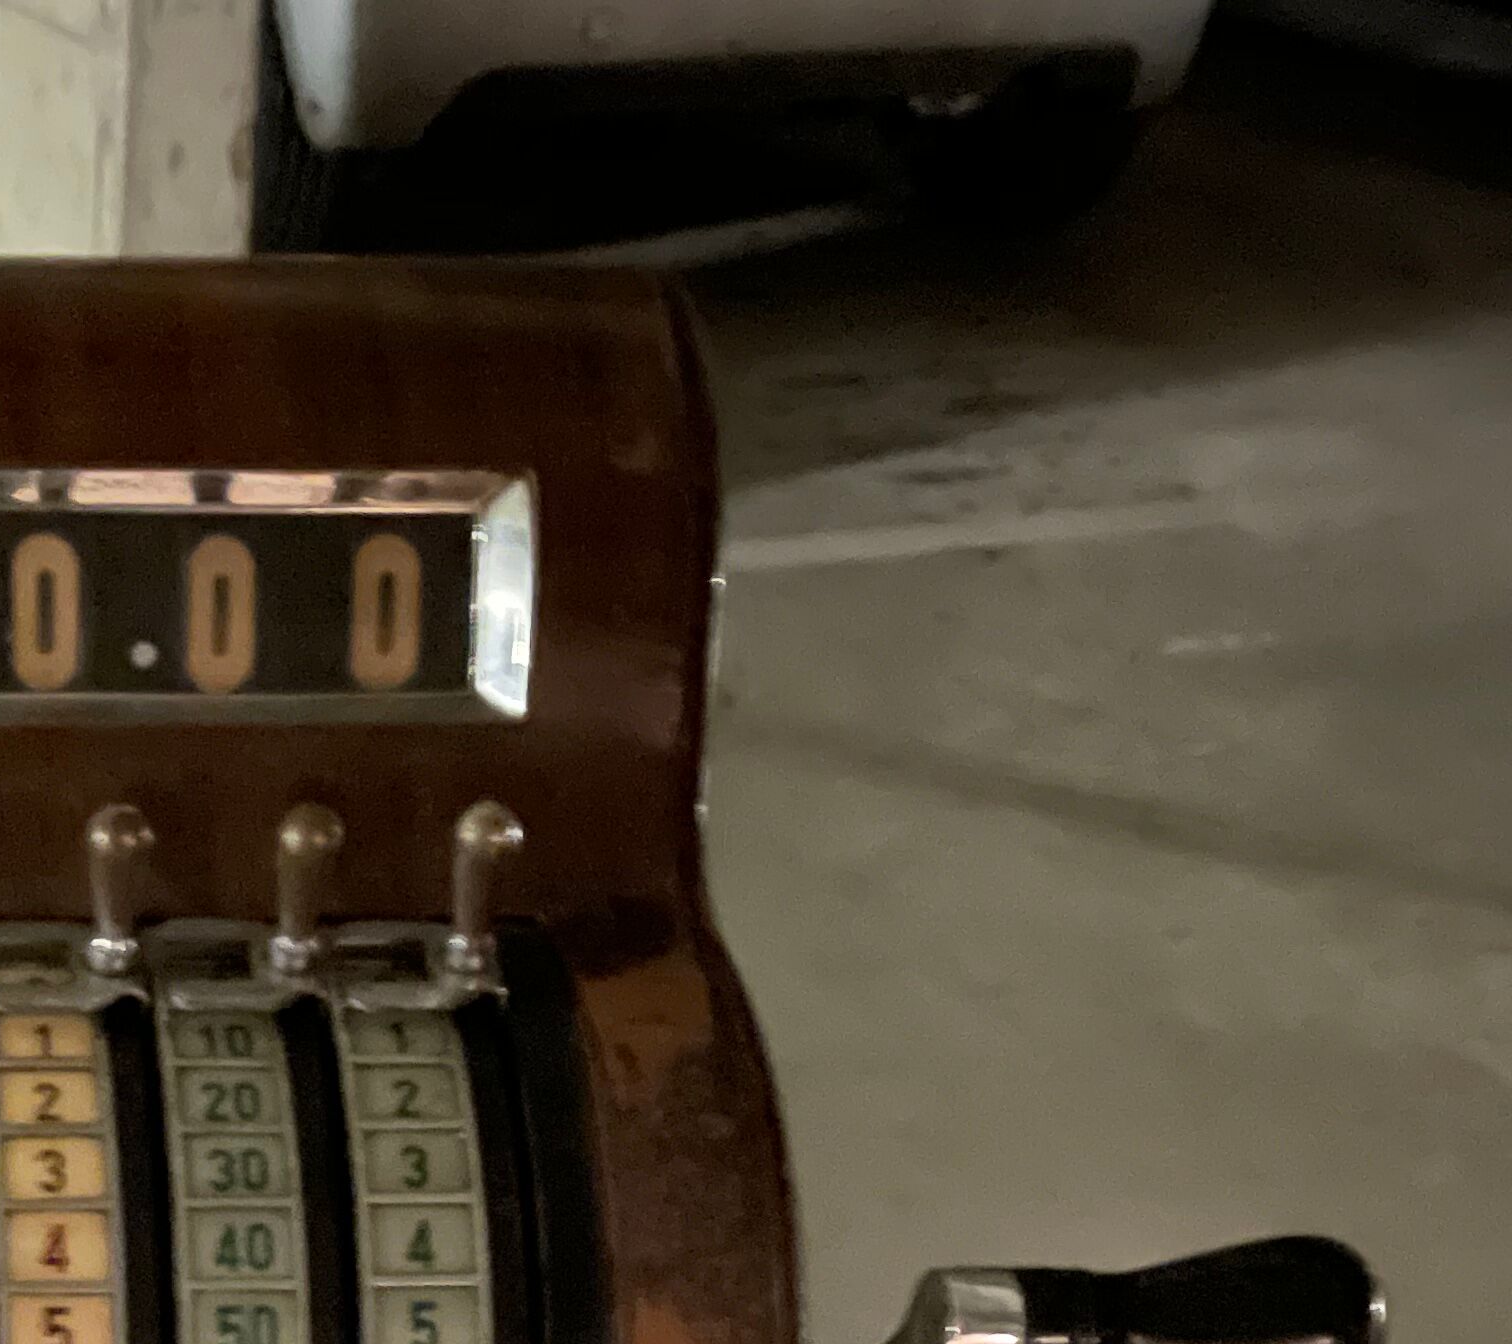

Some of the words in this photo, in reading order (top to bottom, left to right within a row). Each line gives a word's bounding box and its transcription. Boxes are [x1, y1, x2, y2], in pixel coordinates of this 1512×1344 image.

[33, 1024, 53, 1058] 1
[199, 1024, 253, 1057] 10
[389, 1021, 409, 1053] 1
[32, 1082, 61, 1122] 2
[201, 1081, 261, 1122] 20
[392, 1080, 421, 1118] 2
[34, 1149, 68, 1192] 3
[207, 1149, 270, 1192] 30
[400, 1145, 428, 1189] 3
[37, 1224, 70, 1272] 4
[214, 1222, 274, 1271] 40
[406, 1219, 435, 1267] 4
